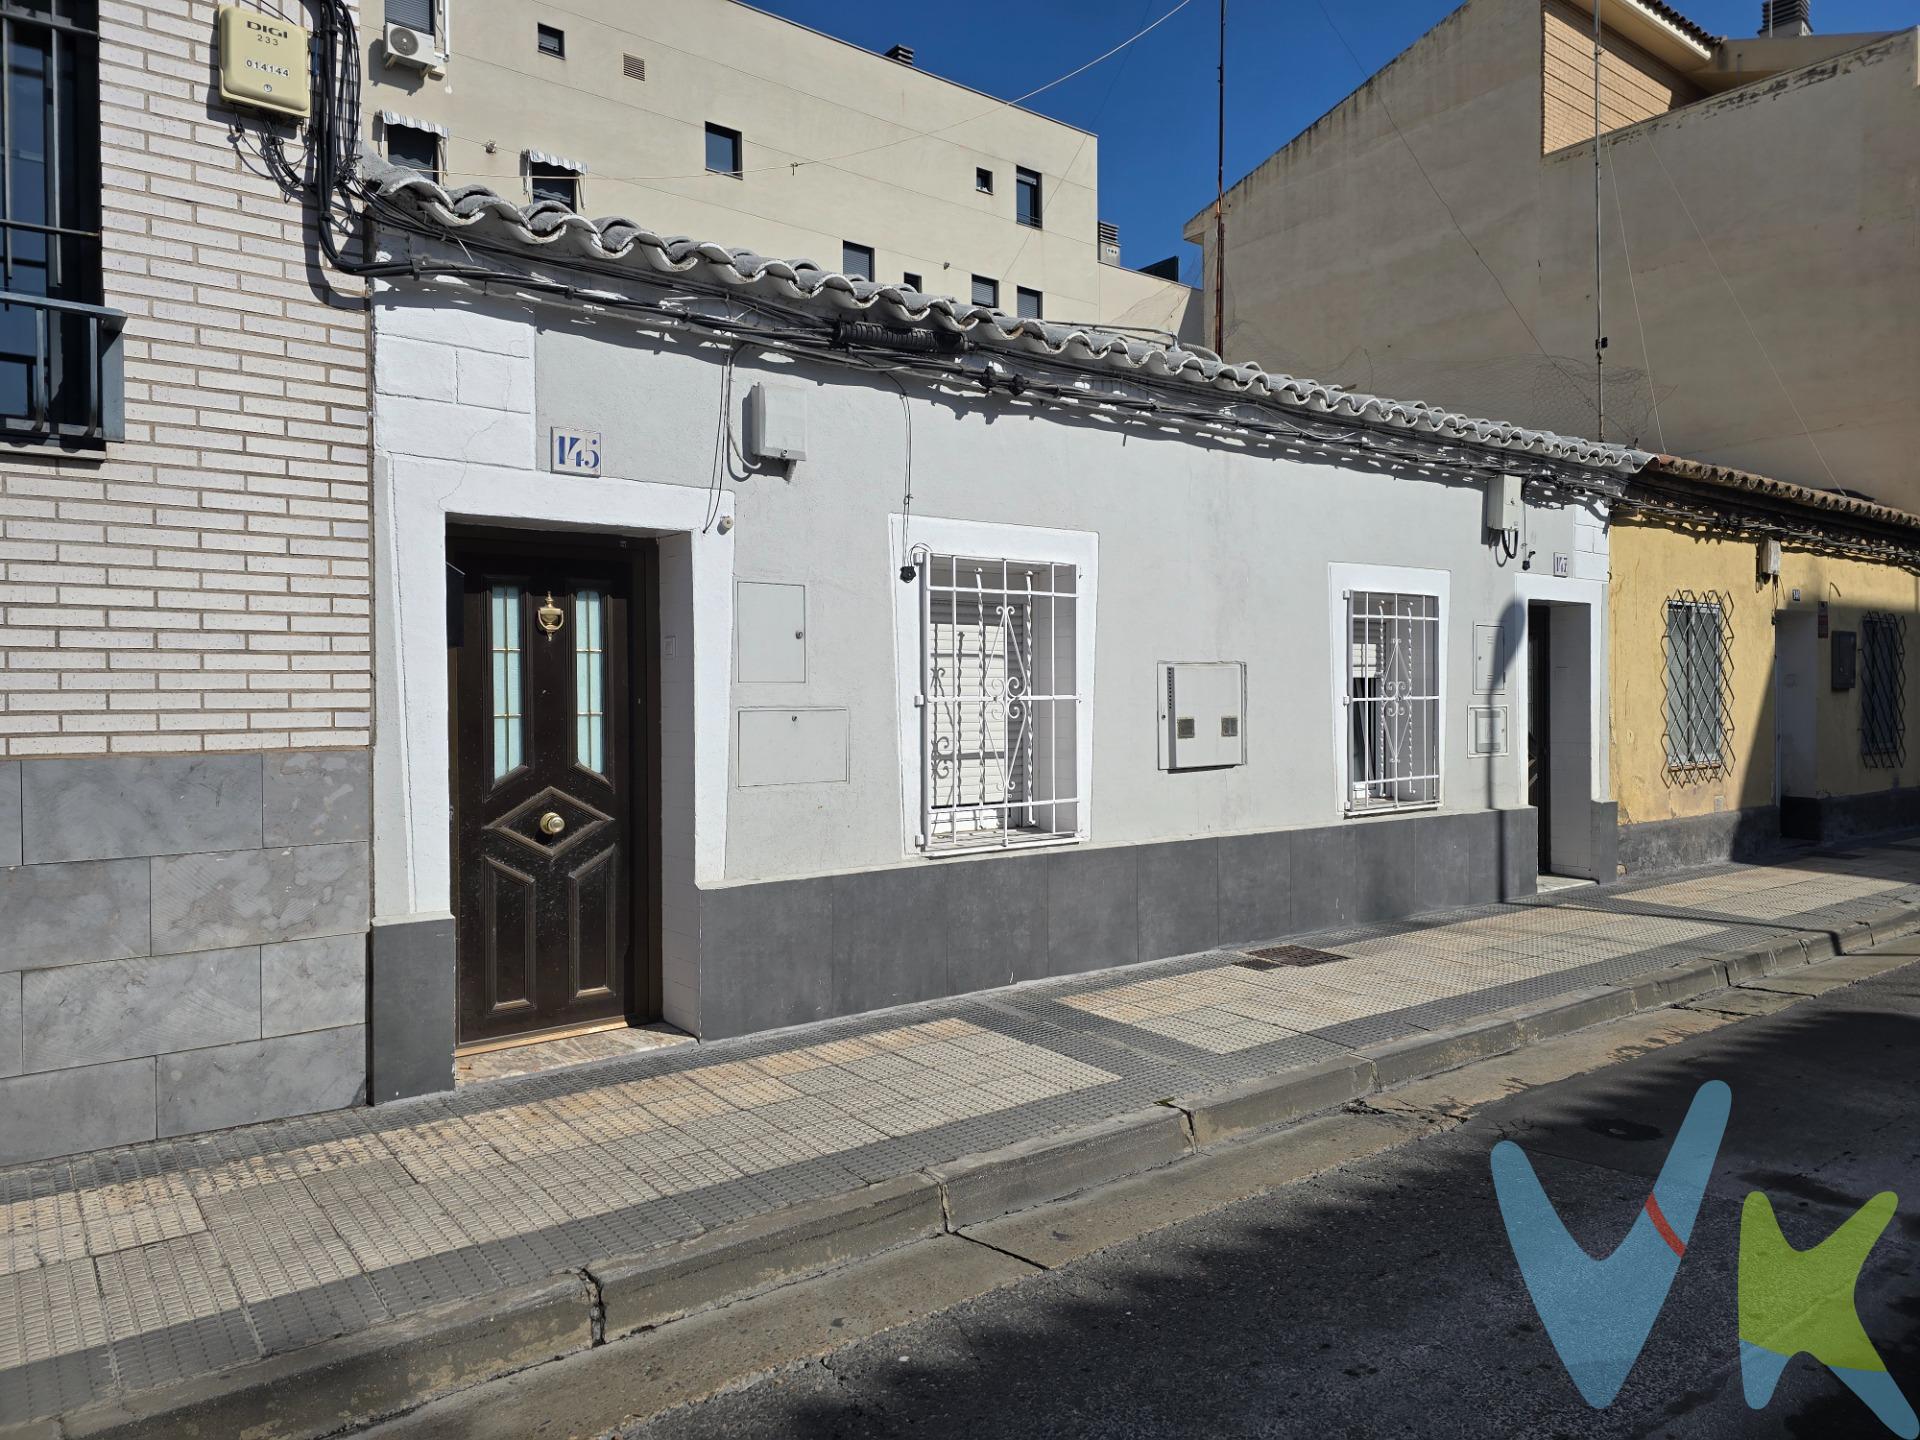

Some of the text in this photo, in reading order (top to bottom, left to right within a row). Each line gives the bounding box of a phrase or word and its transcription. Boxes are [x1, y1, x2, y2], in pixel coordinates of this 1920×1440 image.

[247, 21, 288, 39] DIGI
[257, 34, 279, 46] 233
[246, 60, 289, 77] 014144
[558, 436, 600, 469] 145
